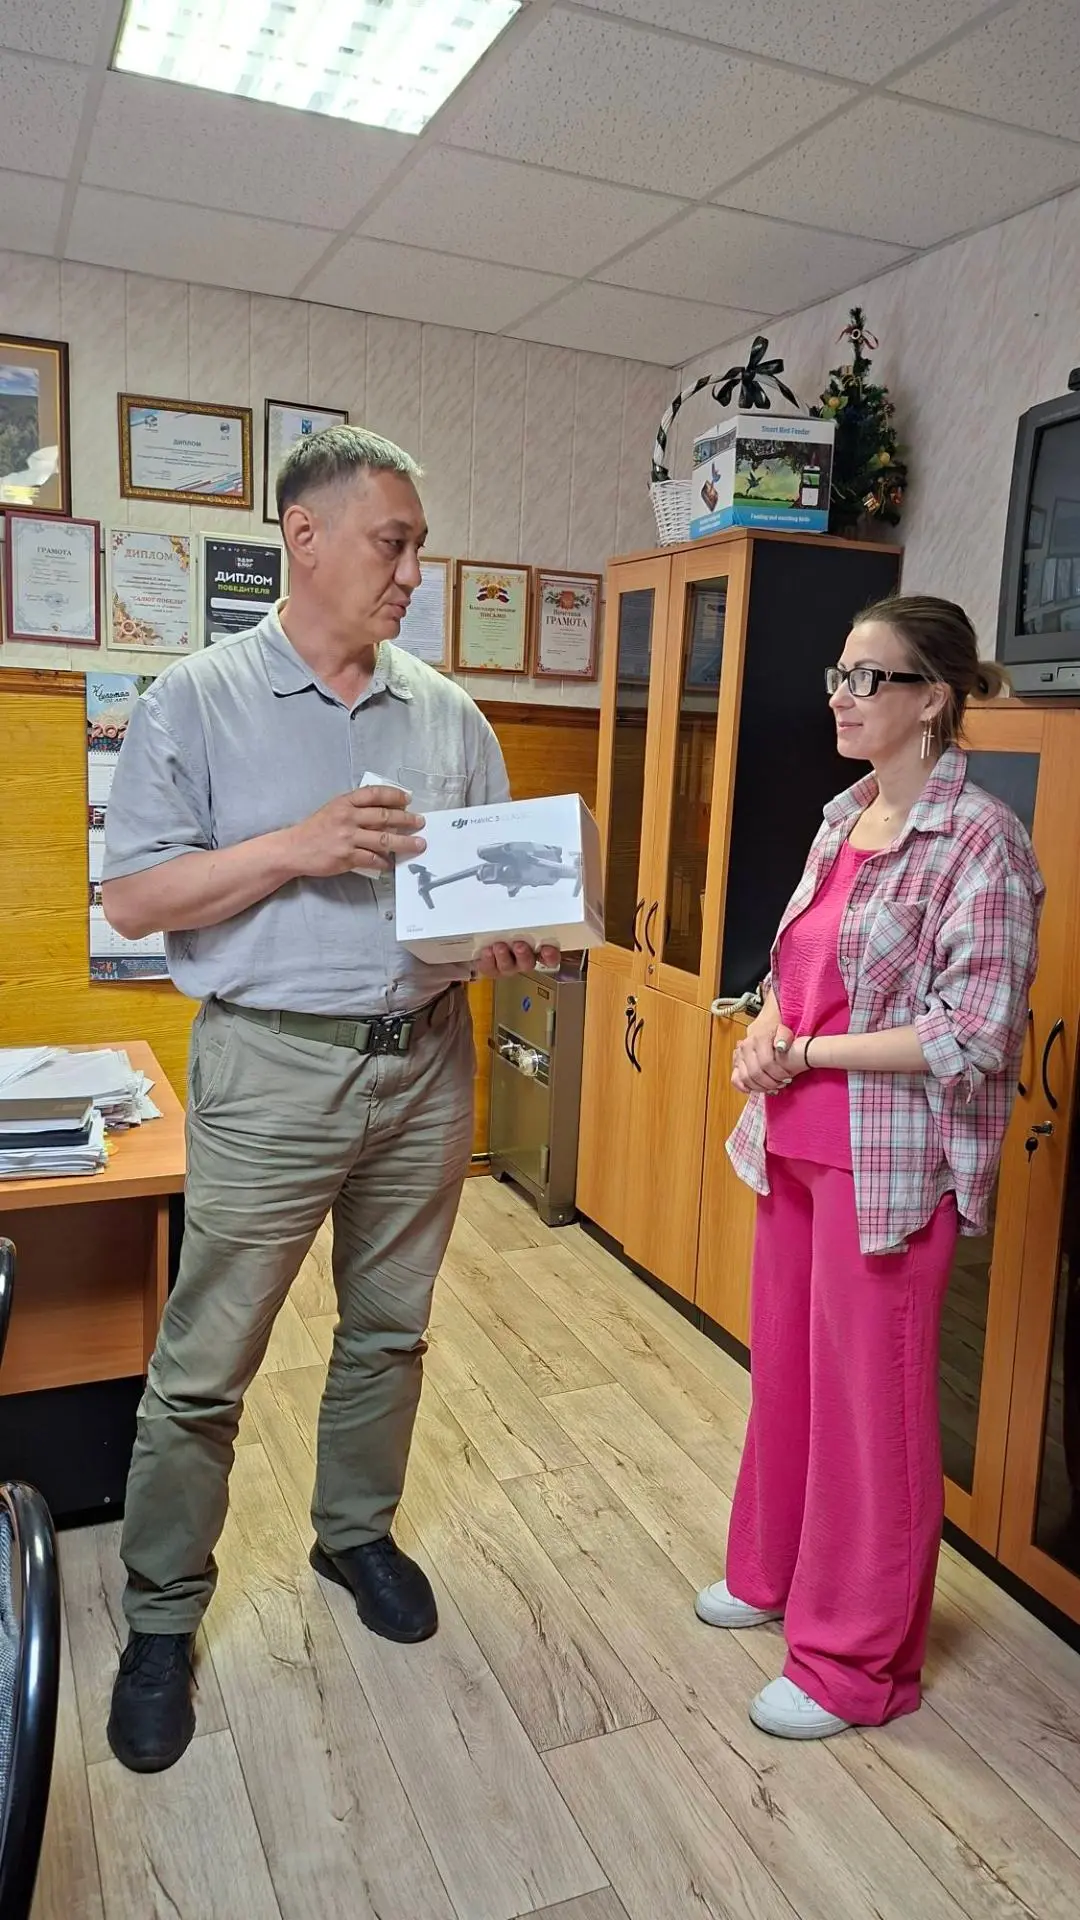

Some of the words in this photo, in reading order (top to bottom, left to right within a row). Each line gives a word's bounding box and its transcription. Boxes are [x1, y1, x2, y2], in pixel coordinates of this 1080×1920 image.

[37, 546, 72, 556] ГРАМОТА
[124, 548, 173, 561] ДИПЛОМ
[214, 571, 273, 586] ДИПЛОМ
[217, 584, 270, 595] ПОБЕДИТЕЛЯ
[546, 616, 588, 628] ГРАМОТА
[91, 723, 127, 738] 202
[470, 815, 493, 825] MAVIC
